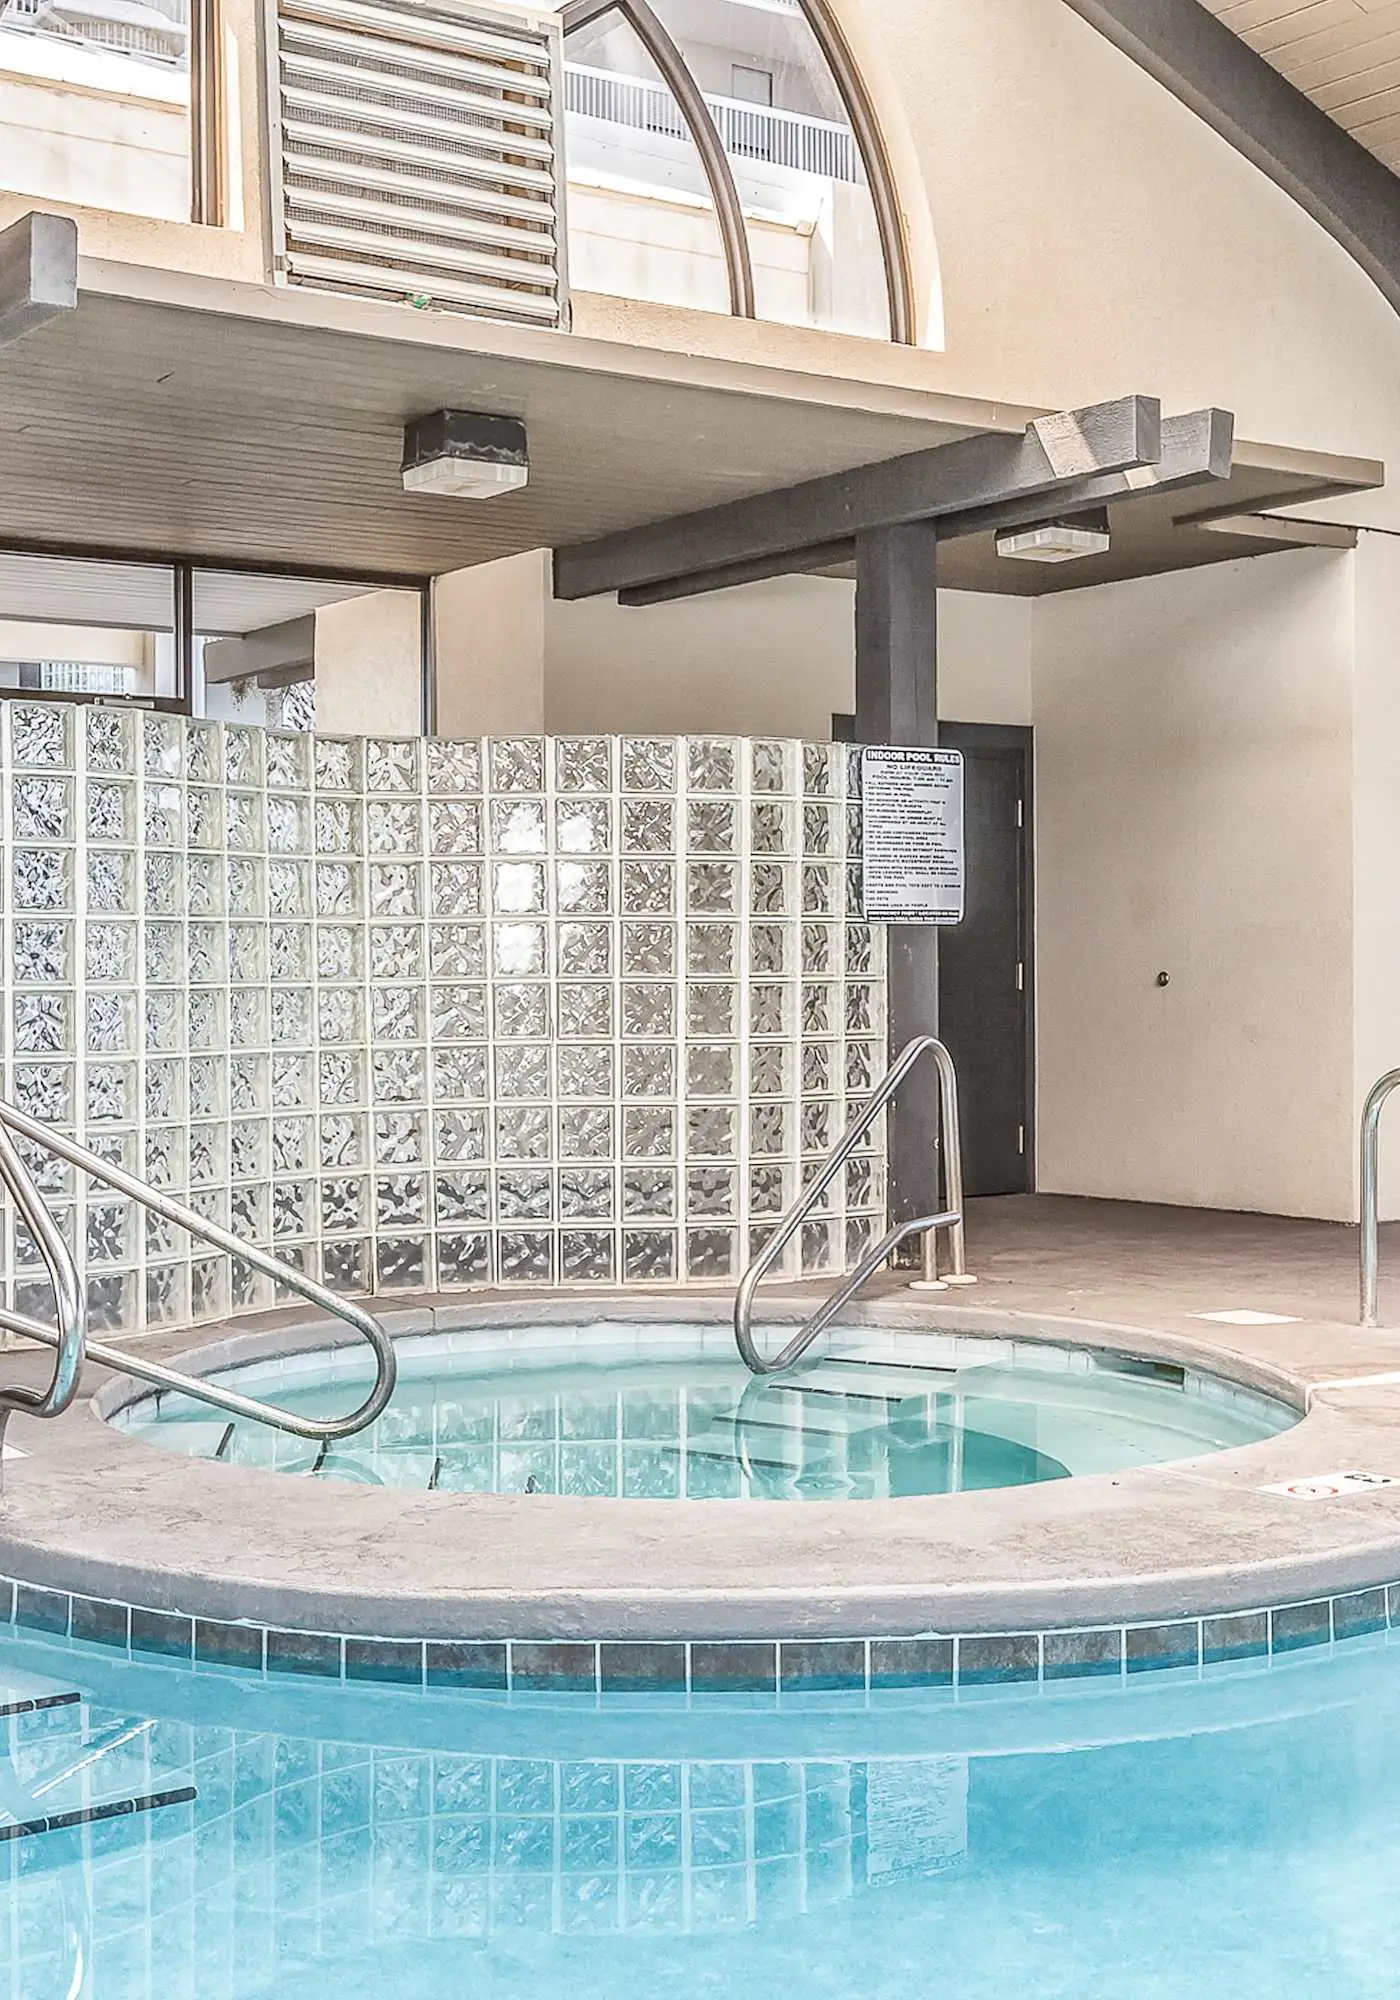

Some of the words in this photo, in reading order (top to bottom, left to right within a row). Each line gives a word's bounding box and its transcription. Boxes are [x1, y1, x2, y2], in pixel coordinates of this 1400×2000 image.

[867, 750, 905, 761] INDOOR
[906, 752, 933, 762] POOL
[934, 754, 960, 764] RULES
